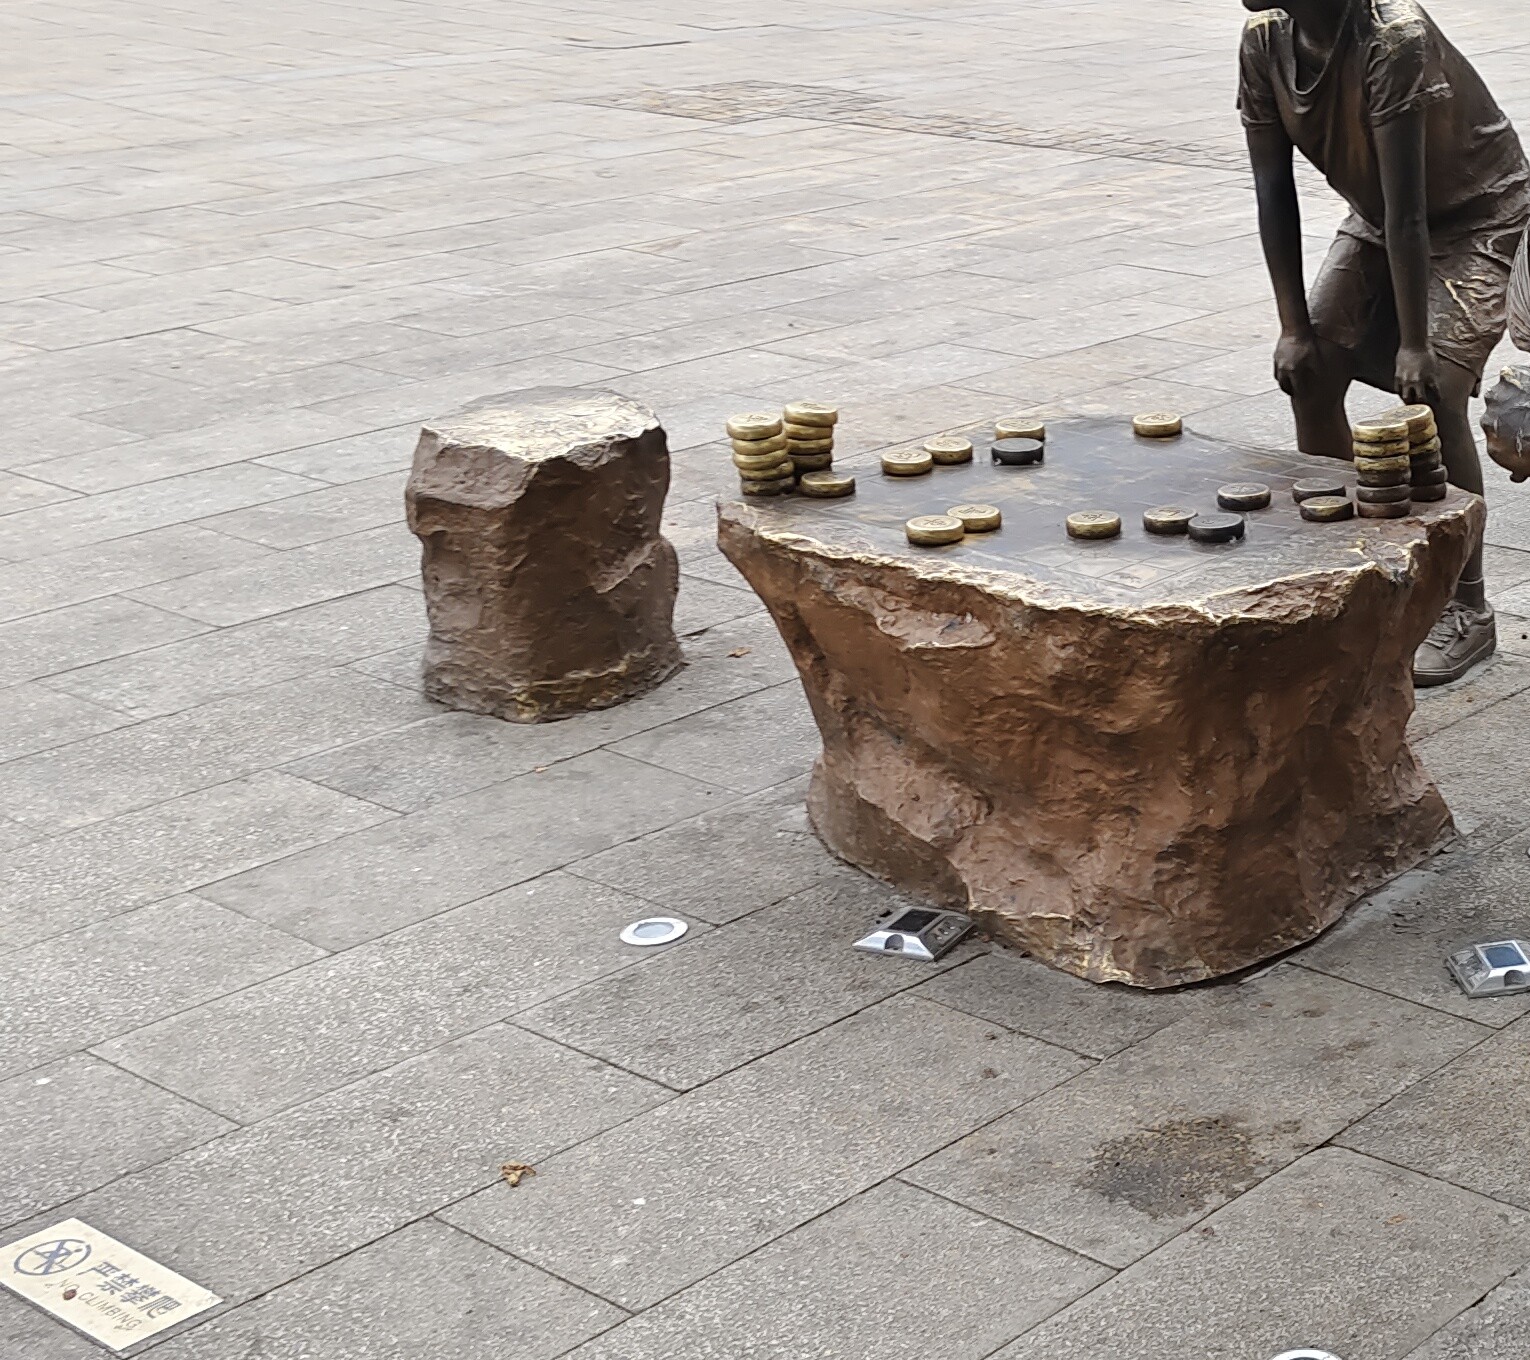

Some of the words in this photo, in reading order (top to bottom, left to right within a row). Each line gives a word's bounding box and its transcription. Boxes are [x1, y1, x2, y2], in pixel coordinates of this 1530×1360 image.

[76, 1261, 183, 1319] 严禁攀爬
[77, 1291, 142, 1330] CLIMBING
